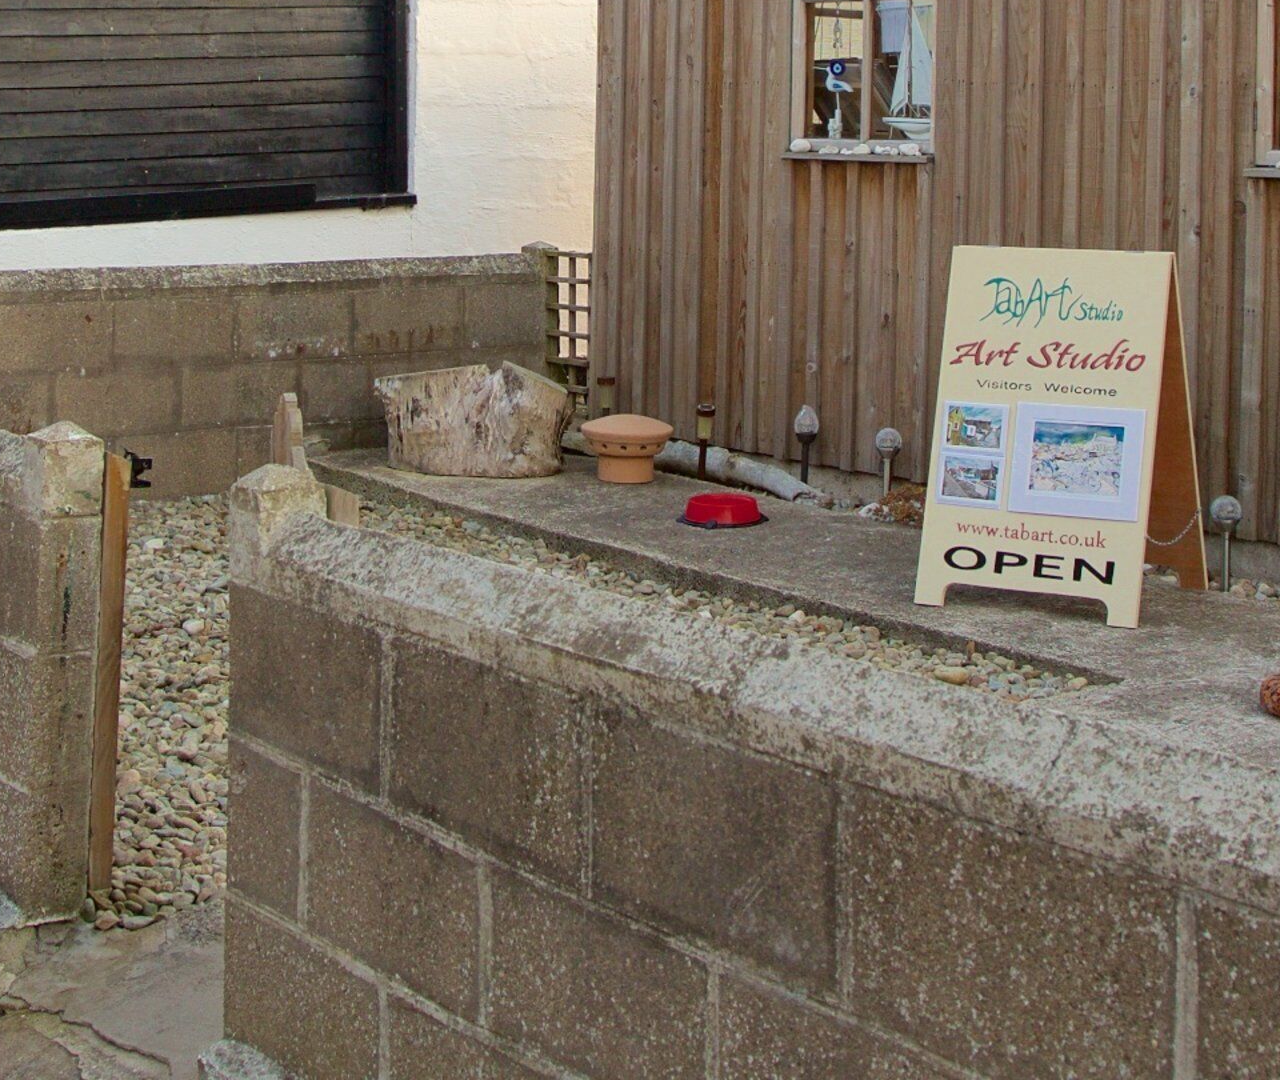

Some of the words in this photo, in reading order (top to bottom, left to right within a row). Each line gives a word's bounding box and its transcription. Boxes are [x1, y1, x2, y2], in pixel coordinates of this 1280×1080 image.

[1074, 300, 1123, 321] Studio
[949, 339, 1021, 367] Art
[1026, 339, 1146, 372] Studio
[976, 378, 1033, 391] Visitors
[1044, 382, 1118, 398] Welcome
[956, 521, 1107, 549] www.tabart.co.uk
[943, 545, 1115, 586] OPEN
